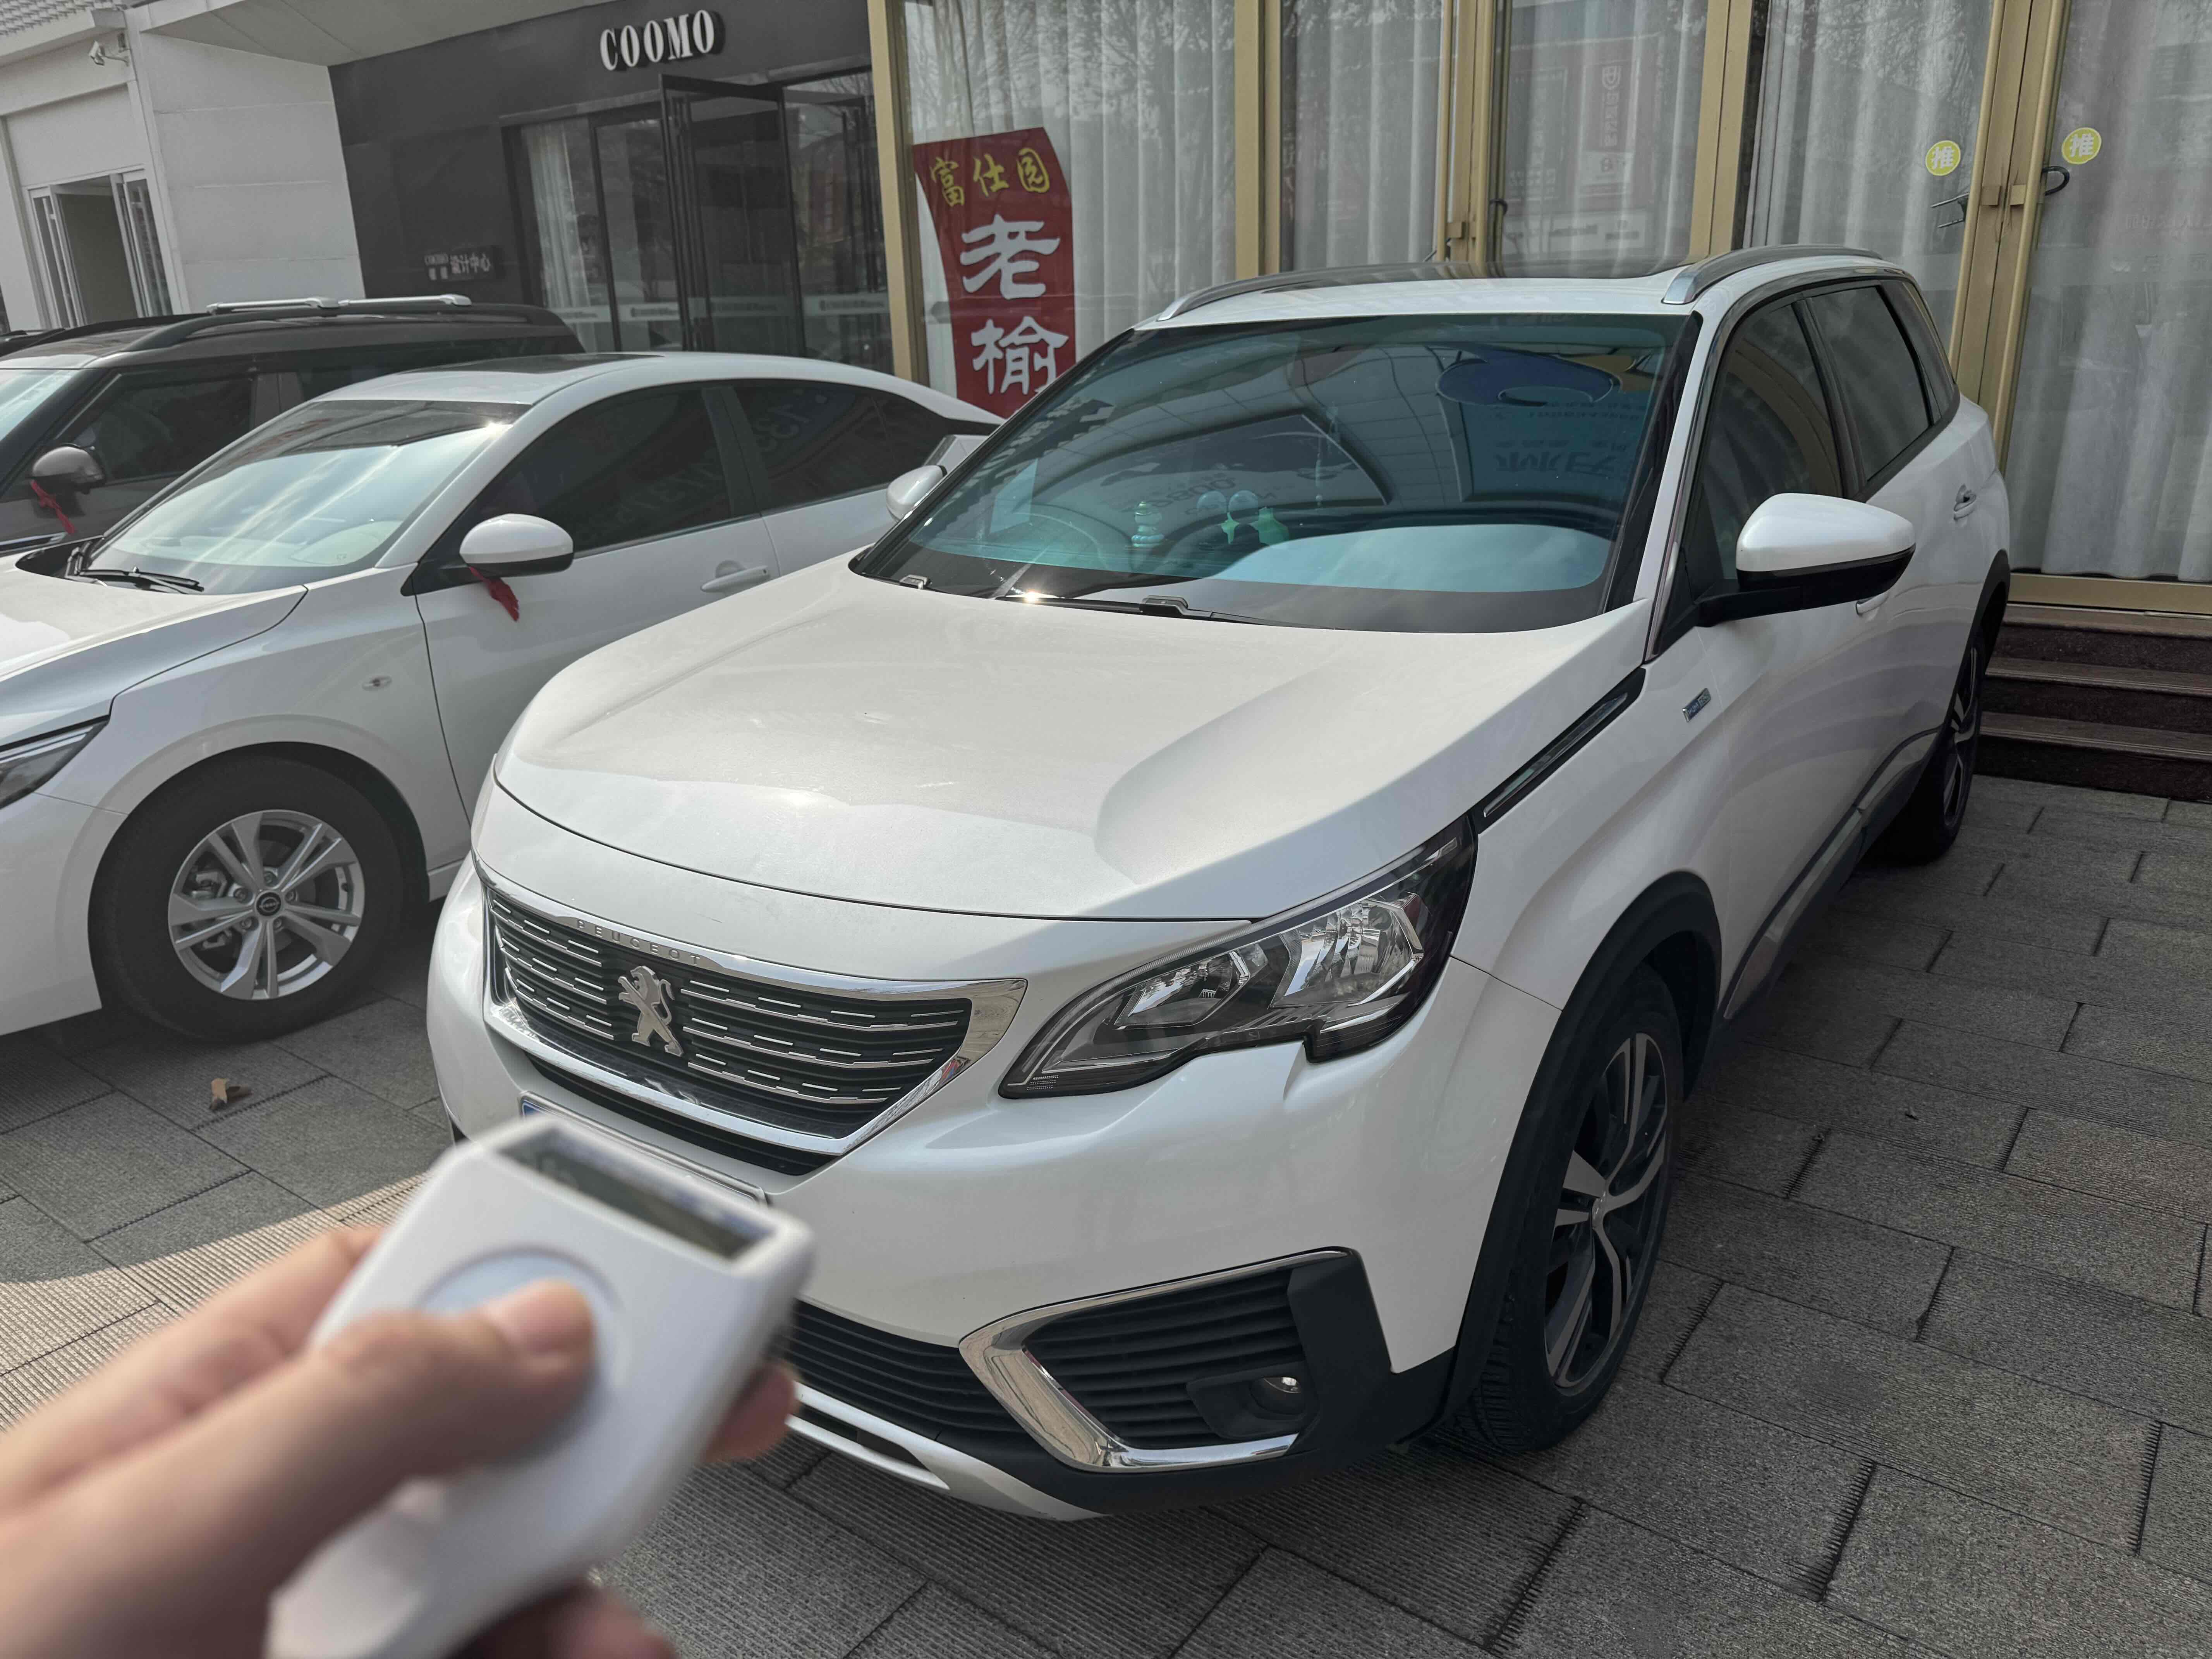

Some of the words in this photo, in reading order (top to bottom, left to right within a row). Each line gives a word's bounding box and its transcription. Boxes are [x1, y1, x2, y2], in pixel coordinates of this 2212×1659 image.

[600, 9, 715, 71] COOMO
[1930, 145, 1955, 170] 推
[2069, 133, 2095, 158] 推
[577, 918, 701, 965] PEUGEOT
